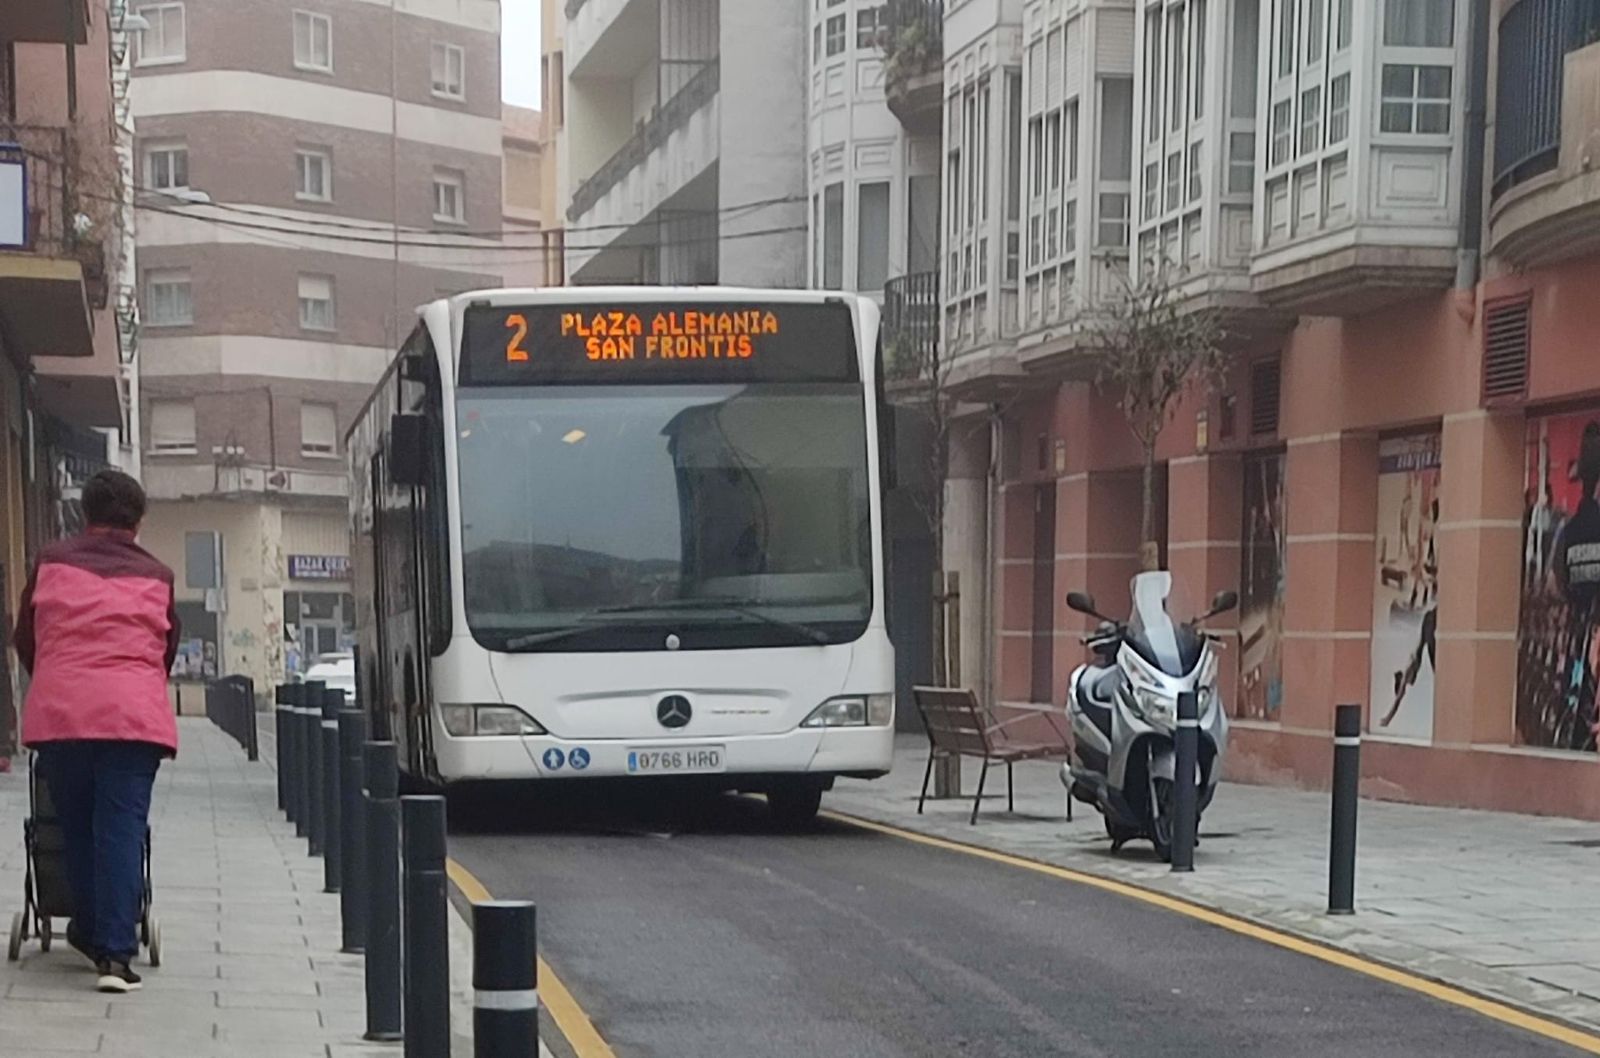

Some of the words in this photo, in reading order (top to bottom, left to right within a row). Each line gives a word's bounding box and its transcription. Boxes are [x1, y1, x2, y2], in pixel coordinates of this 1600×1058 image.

[561, 312, 642, 336] PLAZA
[652, 311, 778, 335] ALEMANIA
[505, 314, 529, 361] 2
[586, 336, 634, 360] SAN
[646, 335, 753, 358] FRONTIS
[639, 752, 682, 769] 0766
